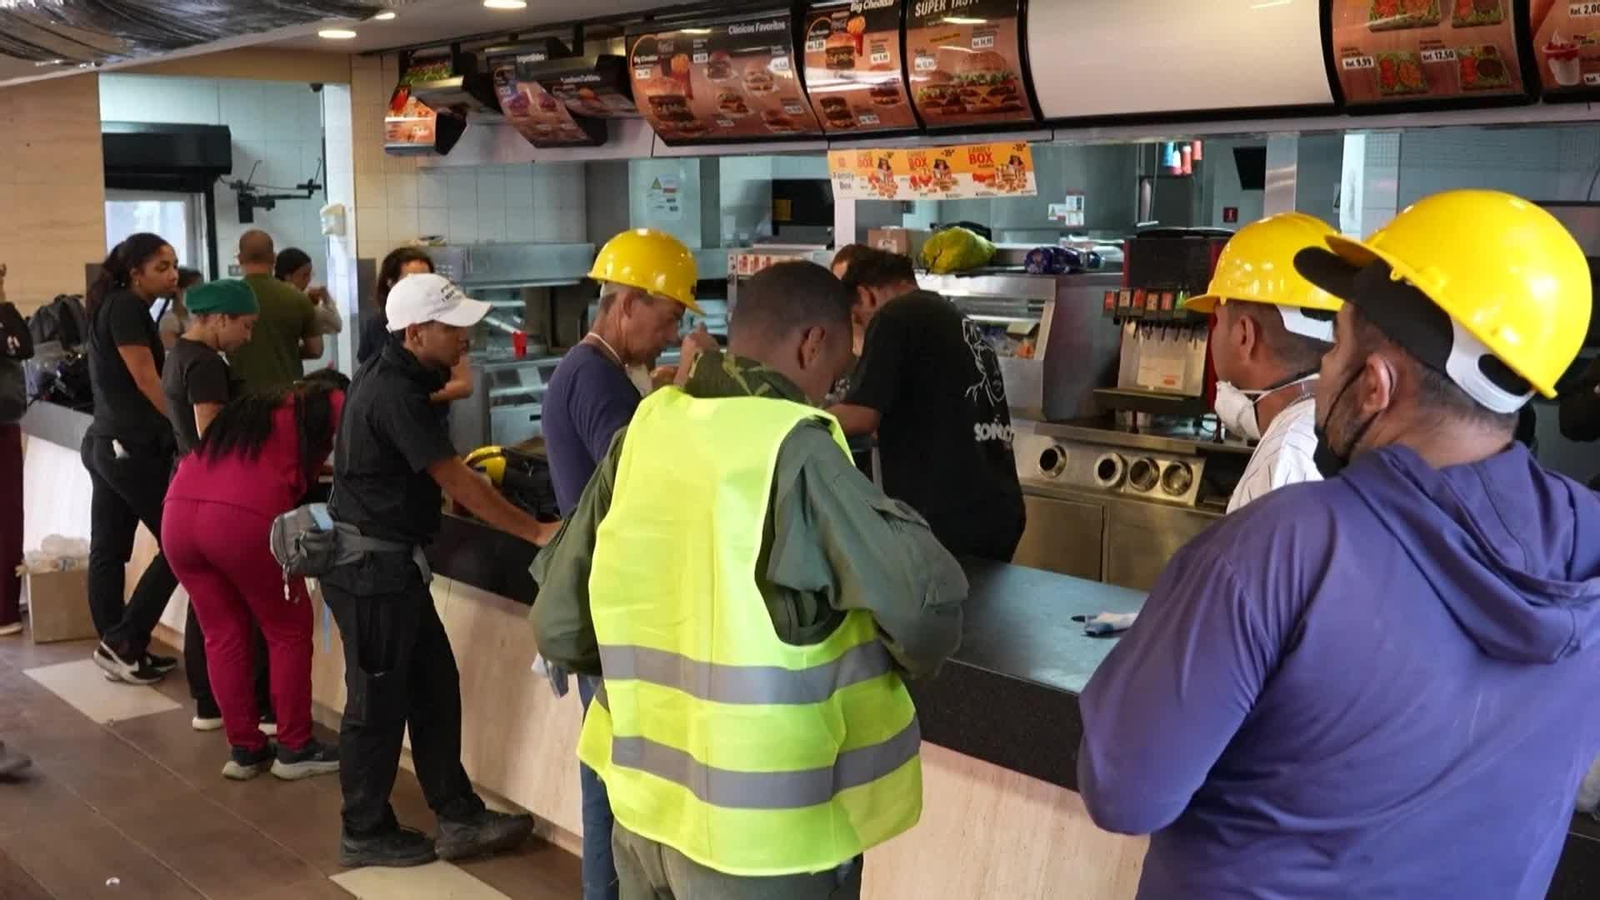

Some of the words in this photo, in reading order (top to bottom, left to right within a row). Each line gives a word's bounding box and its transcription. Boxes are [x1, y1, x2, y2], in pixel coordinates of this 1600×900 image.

[850, 2, 863, 13] Big
[915, 0, 946, 17] SUPER
[1570, 7, 1582, 15] Ref.
[728, 23, 754, 35] Clásicos
[755, 19, 786, 32] Favoritos
[1434, 50, 1454, 60] 12,50
[1356, 57, 1371, 67] 9,99
[908, 157, 928, 169] BOX
[969, 153, 994, 165] BOX
